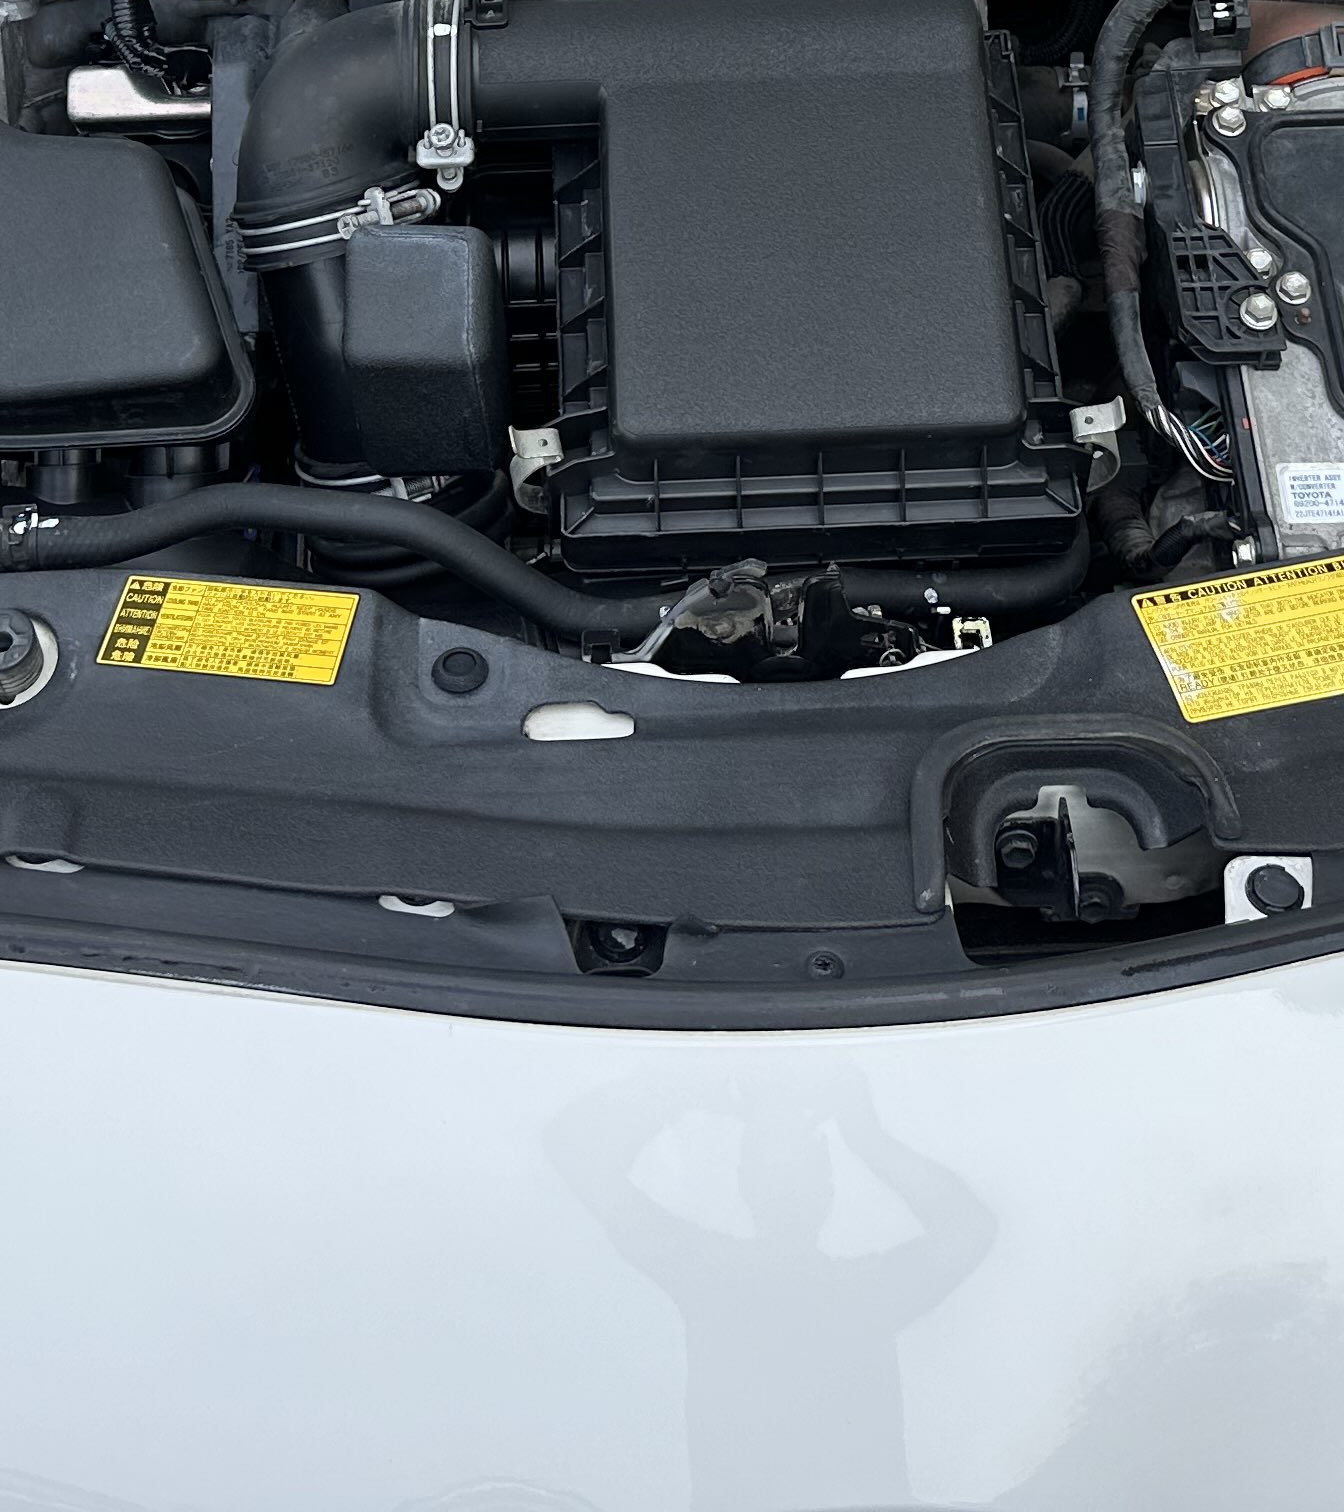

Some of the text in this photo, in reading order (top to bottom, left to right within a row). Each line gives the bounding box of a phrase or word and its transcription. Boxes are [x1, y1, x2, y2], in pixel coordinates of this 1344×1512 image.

[1291, 491, 1332, 499] TOYOTA
[1188, 580, 1247, 599] CAUTION
[1253, 564, 1328, 586] ATTENTION
[126, 593, 164, 604] CAUTION
[120, 608, 158, 619] ATTENTION
[1179, 678, 1215, 691] READY
